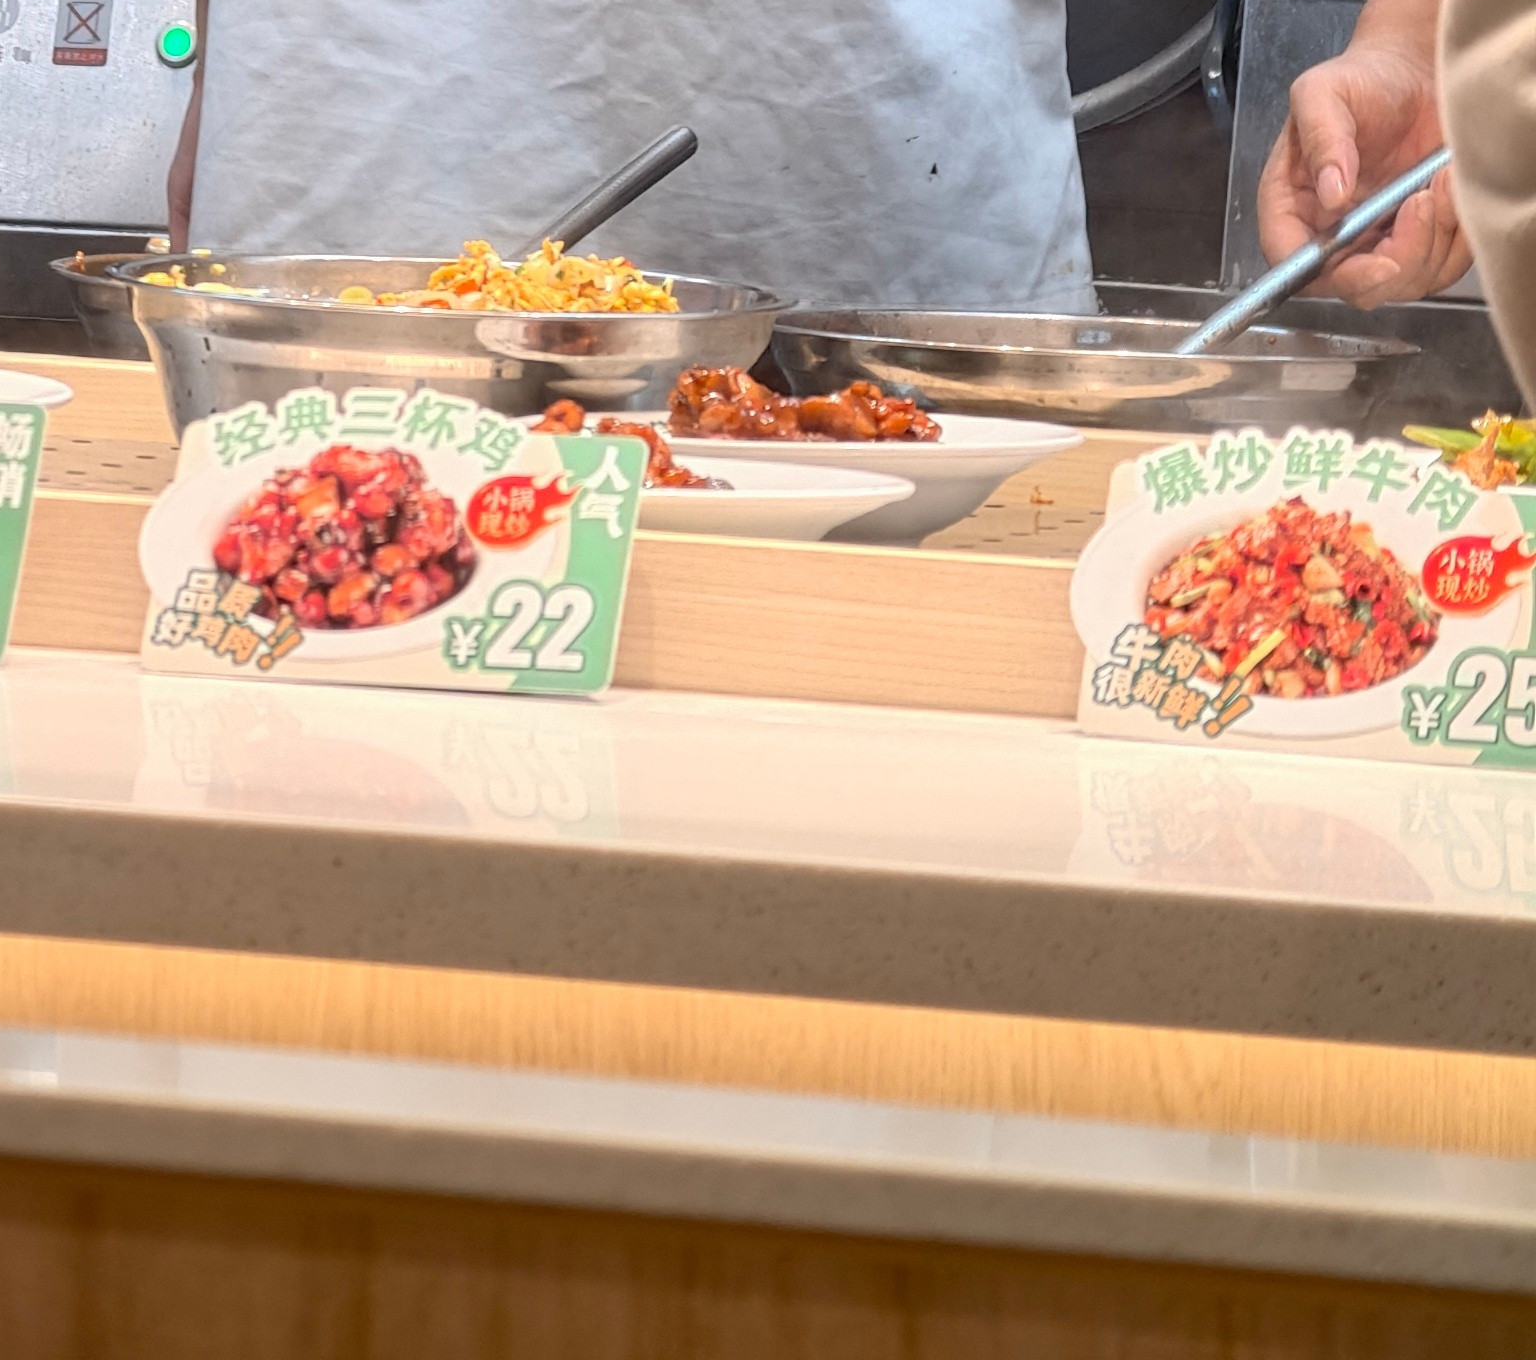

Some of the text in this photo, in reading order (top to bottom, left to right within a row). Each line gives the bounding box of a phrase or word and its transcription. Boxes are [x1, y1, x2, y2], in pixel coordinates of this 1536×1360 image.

[214, 393, 523, 471] 经典三杯鸡
[579, 445, 631, 538] 人气
[1143, 436, 1479, 531] 爆炒鲜牛肉
[176, 573, 261, 621] 品质
[448, 584, 594, 670] ¥22
[1113, 625, 1202, 679] 牛肉
